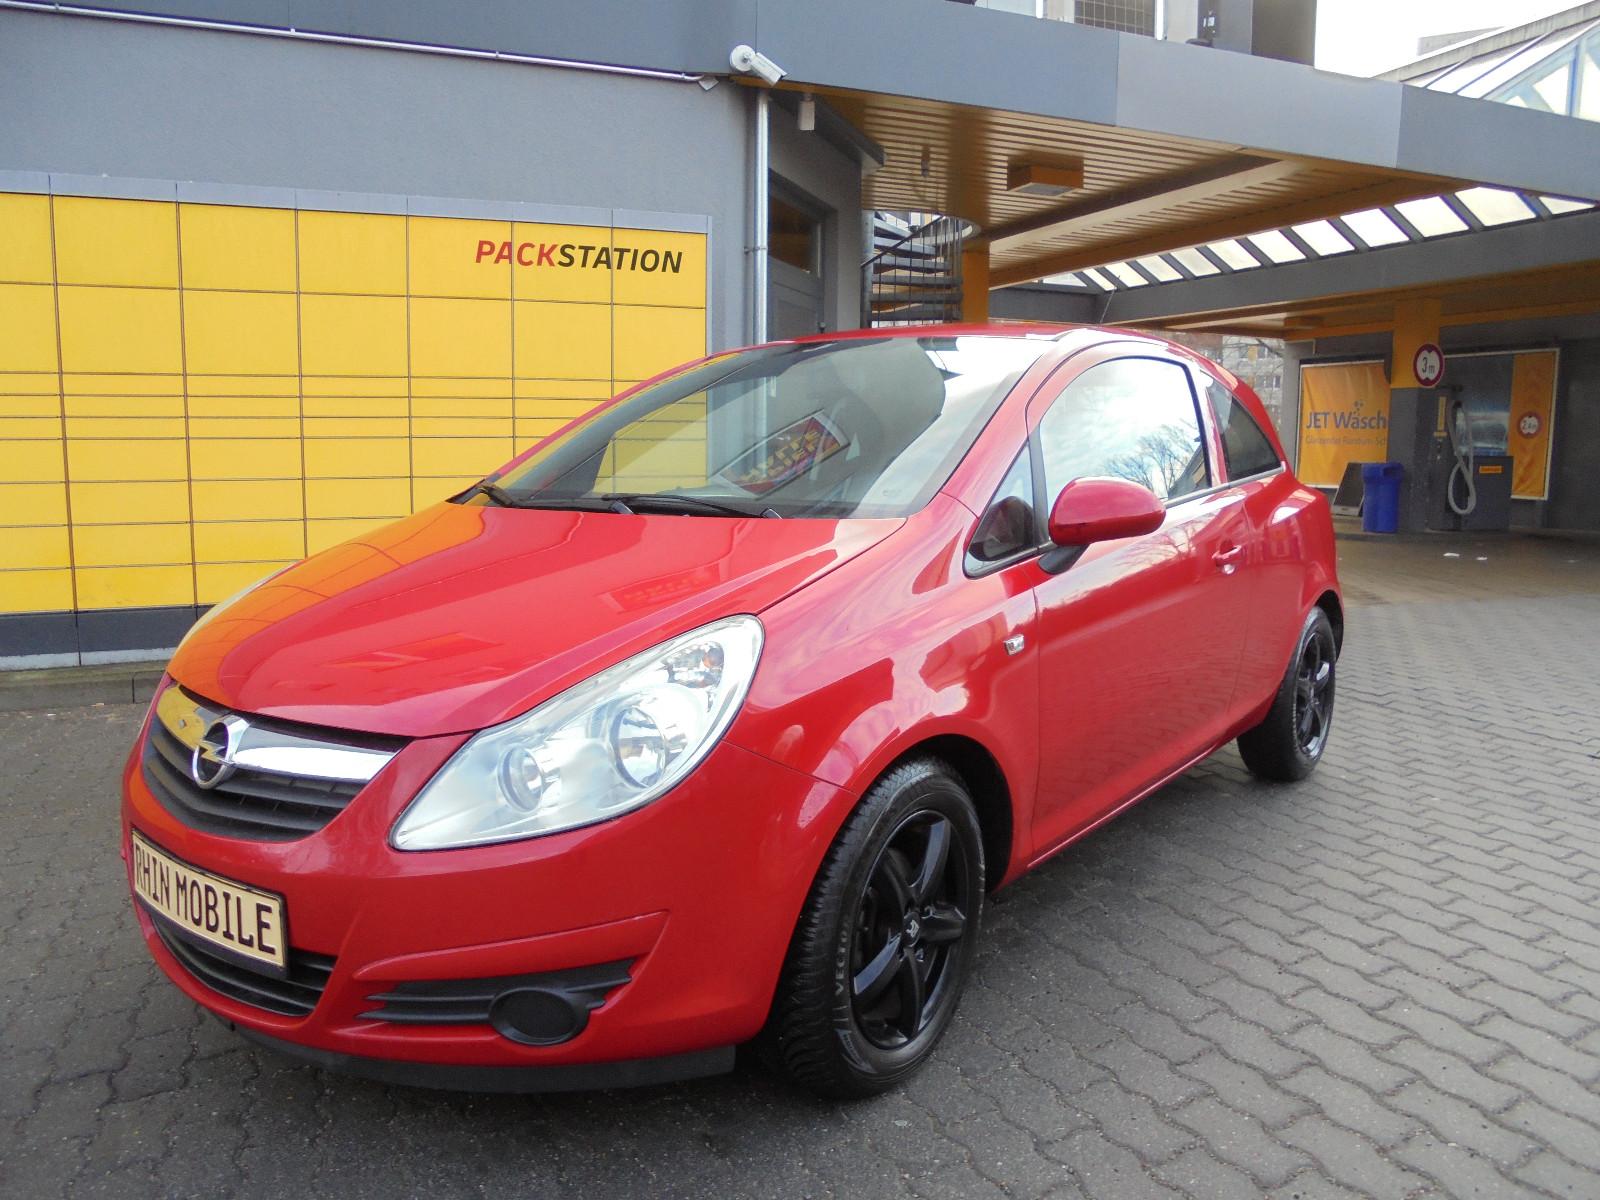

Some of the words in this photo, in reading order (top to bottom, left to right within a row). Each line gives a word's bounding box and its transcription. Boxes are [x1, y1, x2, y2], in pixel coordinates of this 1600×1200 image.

[475, 240, 683, 273] PACKSTATION
[1306, 411, 1330, 429] JET
[135, 843, 170, 910] RHIN
[175, 870, 276, 955] MOBILE
